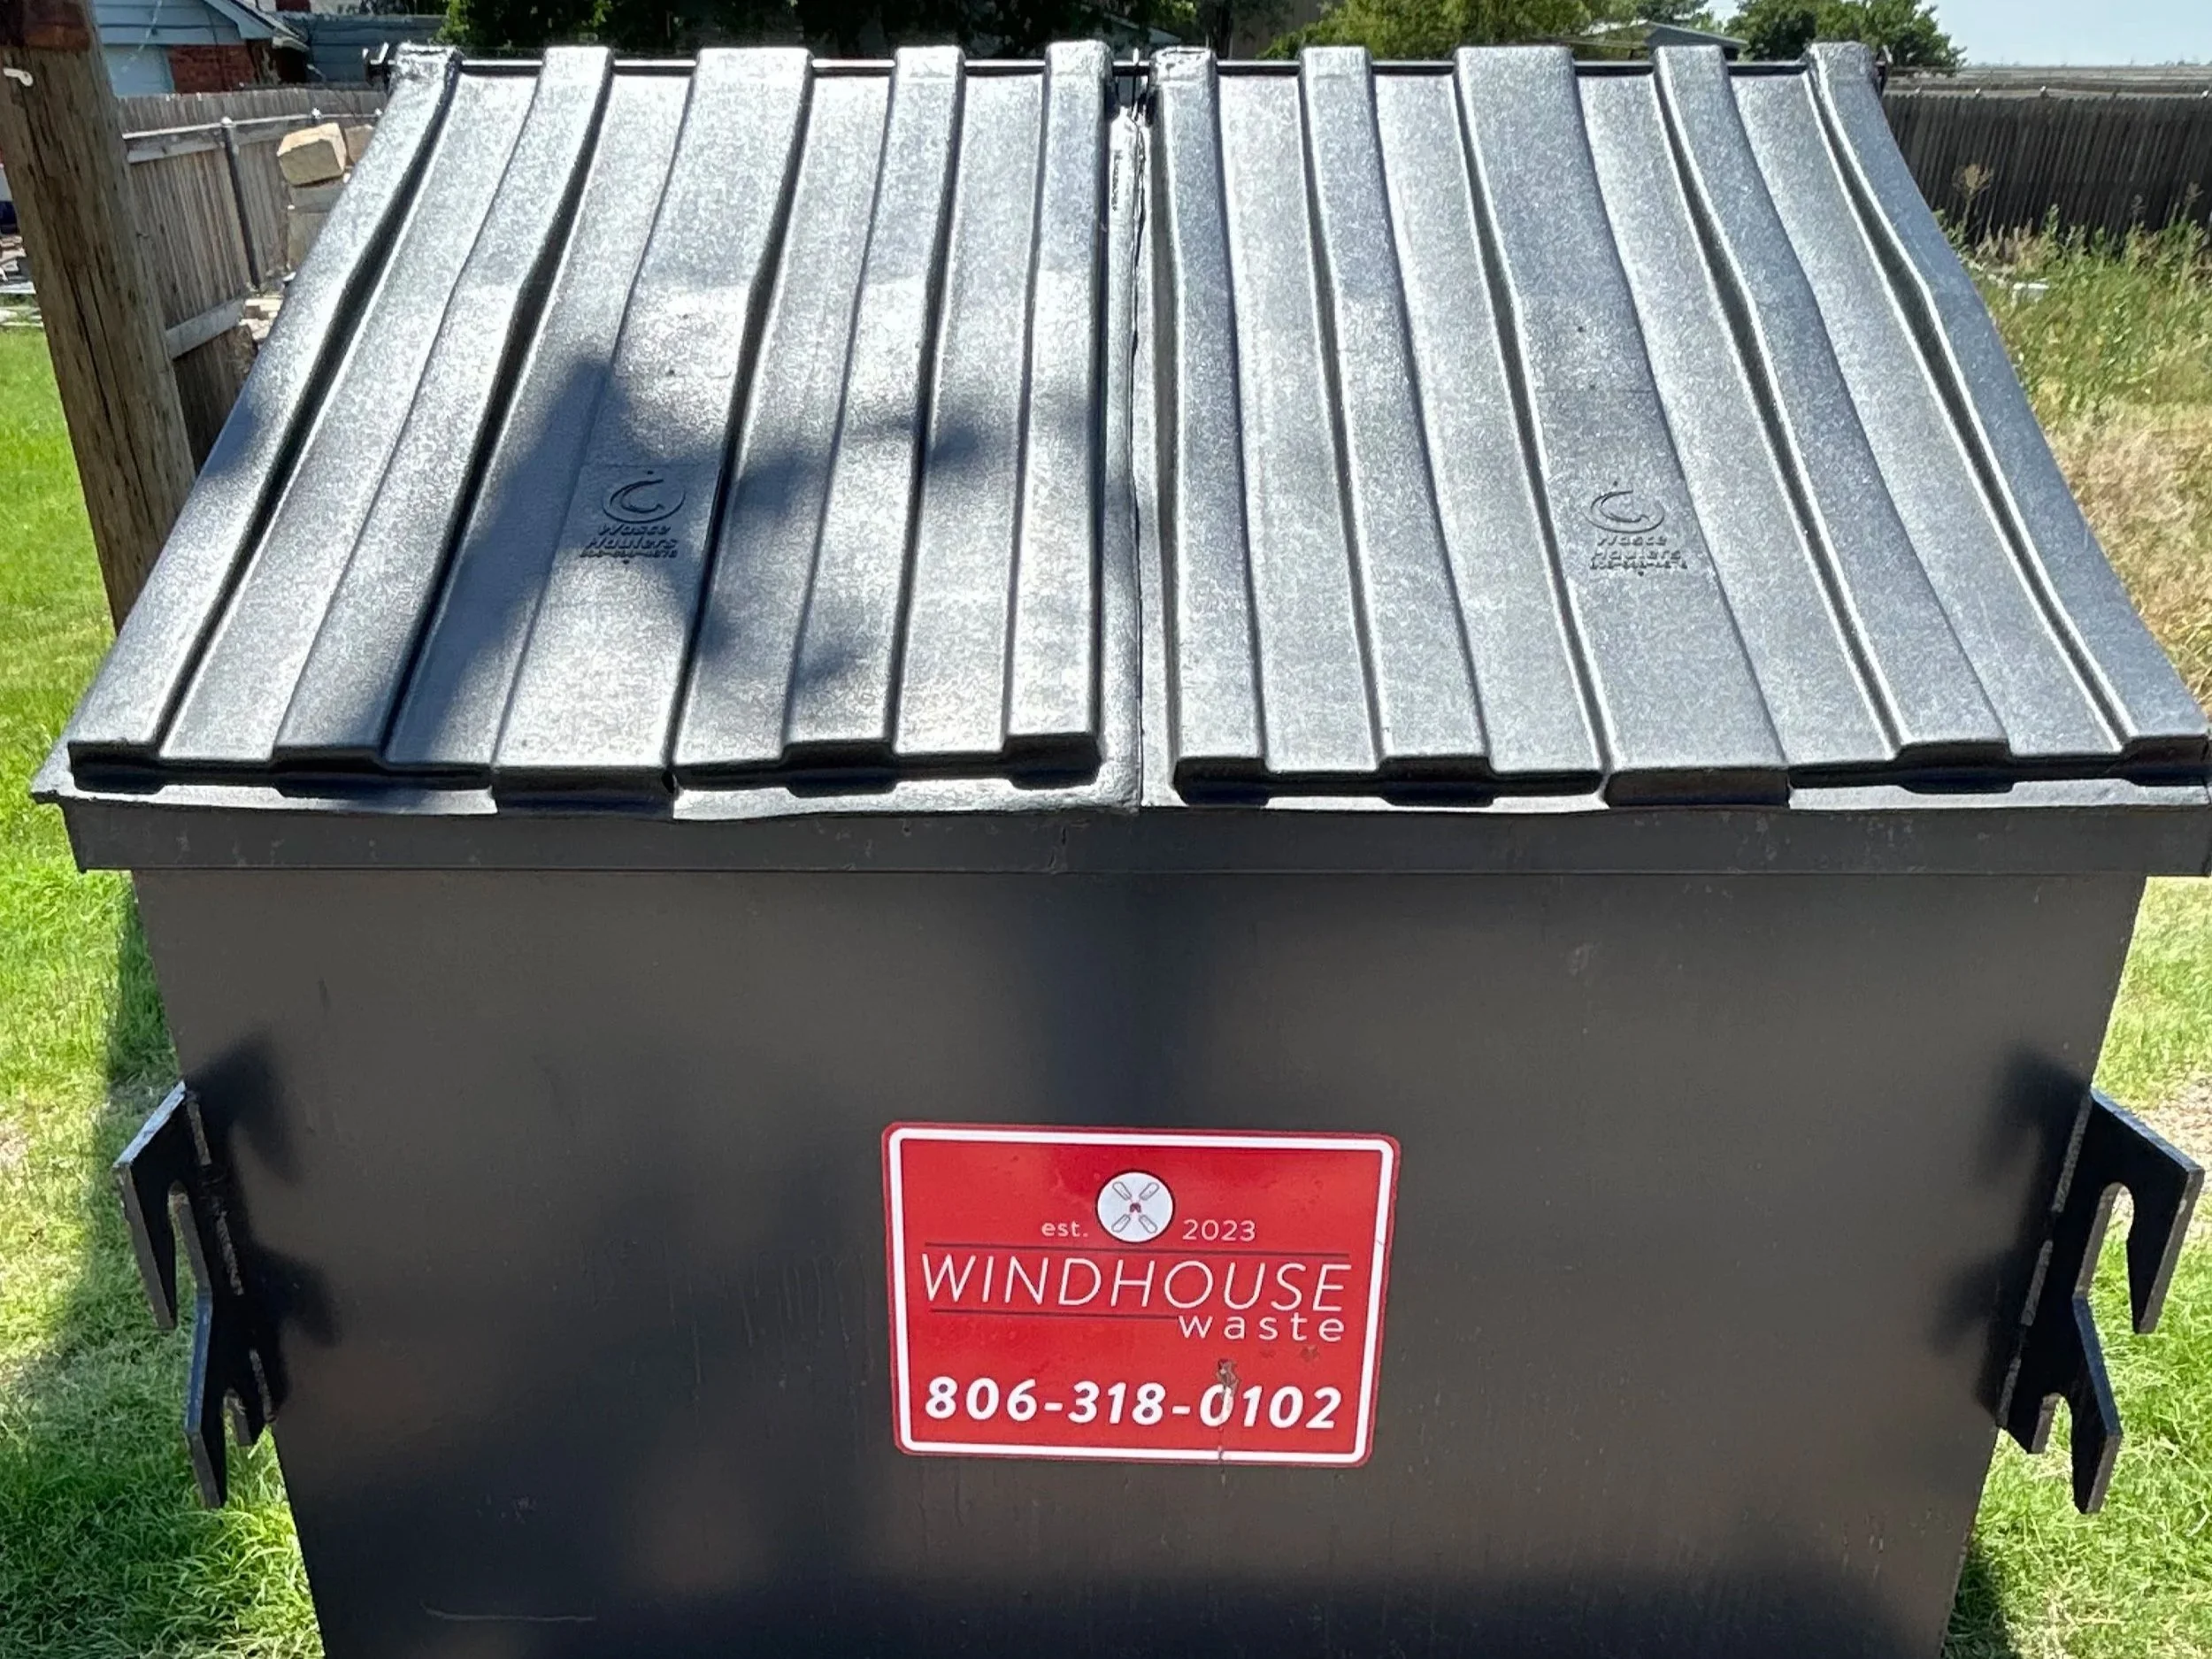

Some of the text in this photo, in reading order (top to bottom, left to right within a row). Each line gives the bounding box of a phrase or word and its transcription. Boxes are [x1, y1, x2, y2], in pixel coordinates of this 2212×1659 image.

[1041, 1218, 1256, 1242] est. 2023
[922, 1253, 1352, 1312] WINDHOUSE
[1178, 1311, 1345, 1342] waste
[925, 1375, 1342, 1430] 806-318-0102
